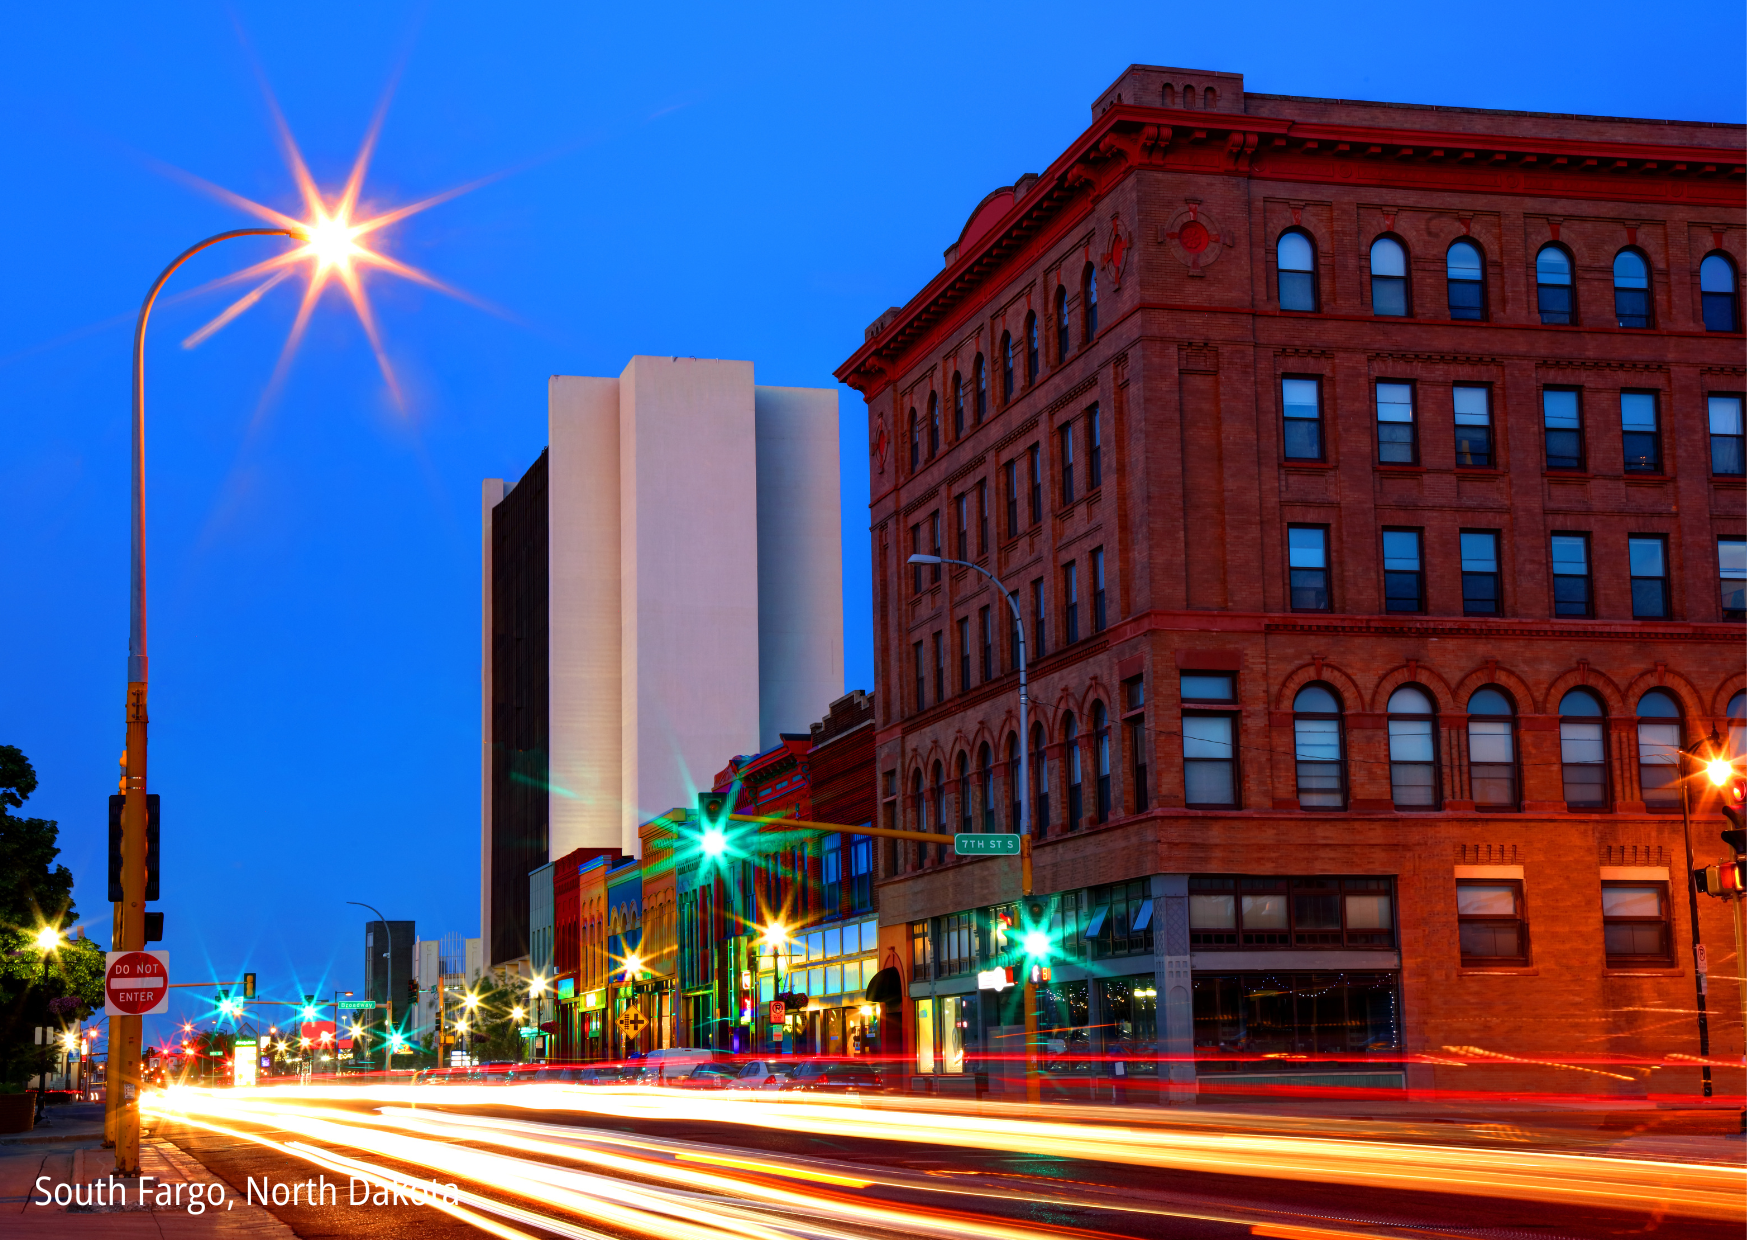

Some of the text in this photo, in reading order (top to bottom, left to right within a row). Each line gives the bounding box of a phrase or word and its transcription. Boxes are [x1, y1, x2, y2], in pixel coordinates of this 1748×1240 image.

[961, 840, 1014, 849] 7TH ST S
[115, 963, 159, 975] DO NOT
[119, 991, 154, 1002] ENTER
